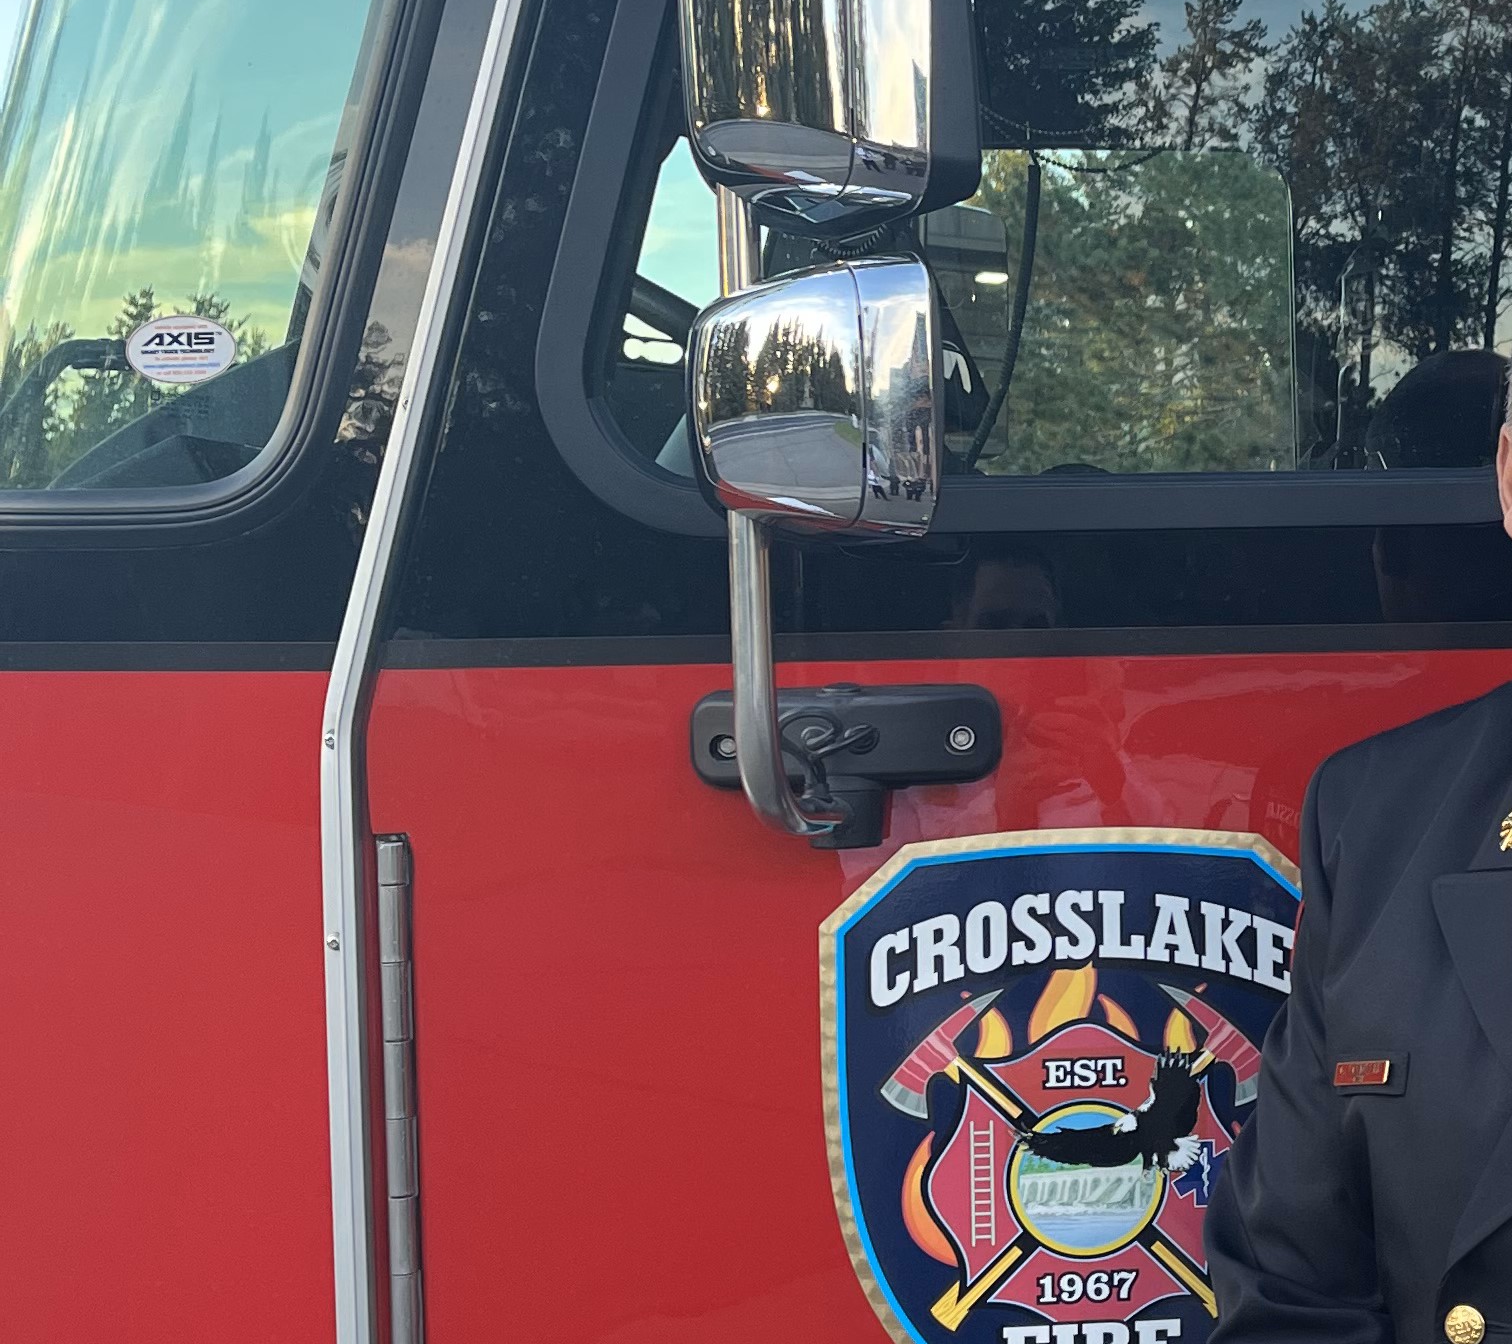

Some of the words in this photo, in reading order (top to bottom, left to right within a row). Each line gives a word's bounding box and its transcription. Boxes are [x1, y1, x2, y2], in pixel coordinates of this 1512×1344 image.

[142, 332, 215, 348] AXIS
[869, 889, 1294, 1007] CROSSLAKE
[1044, 1060, 1127, 1088] EST.
[1037, 1271, 1138, 1304] 1967
